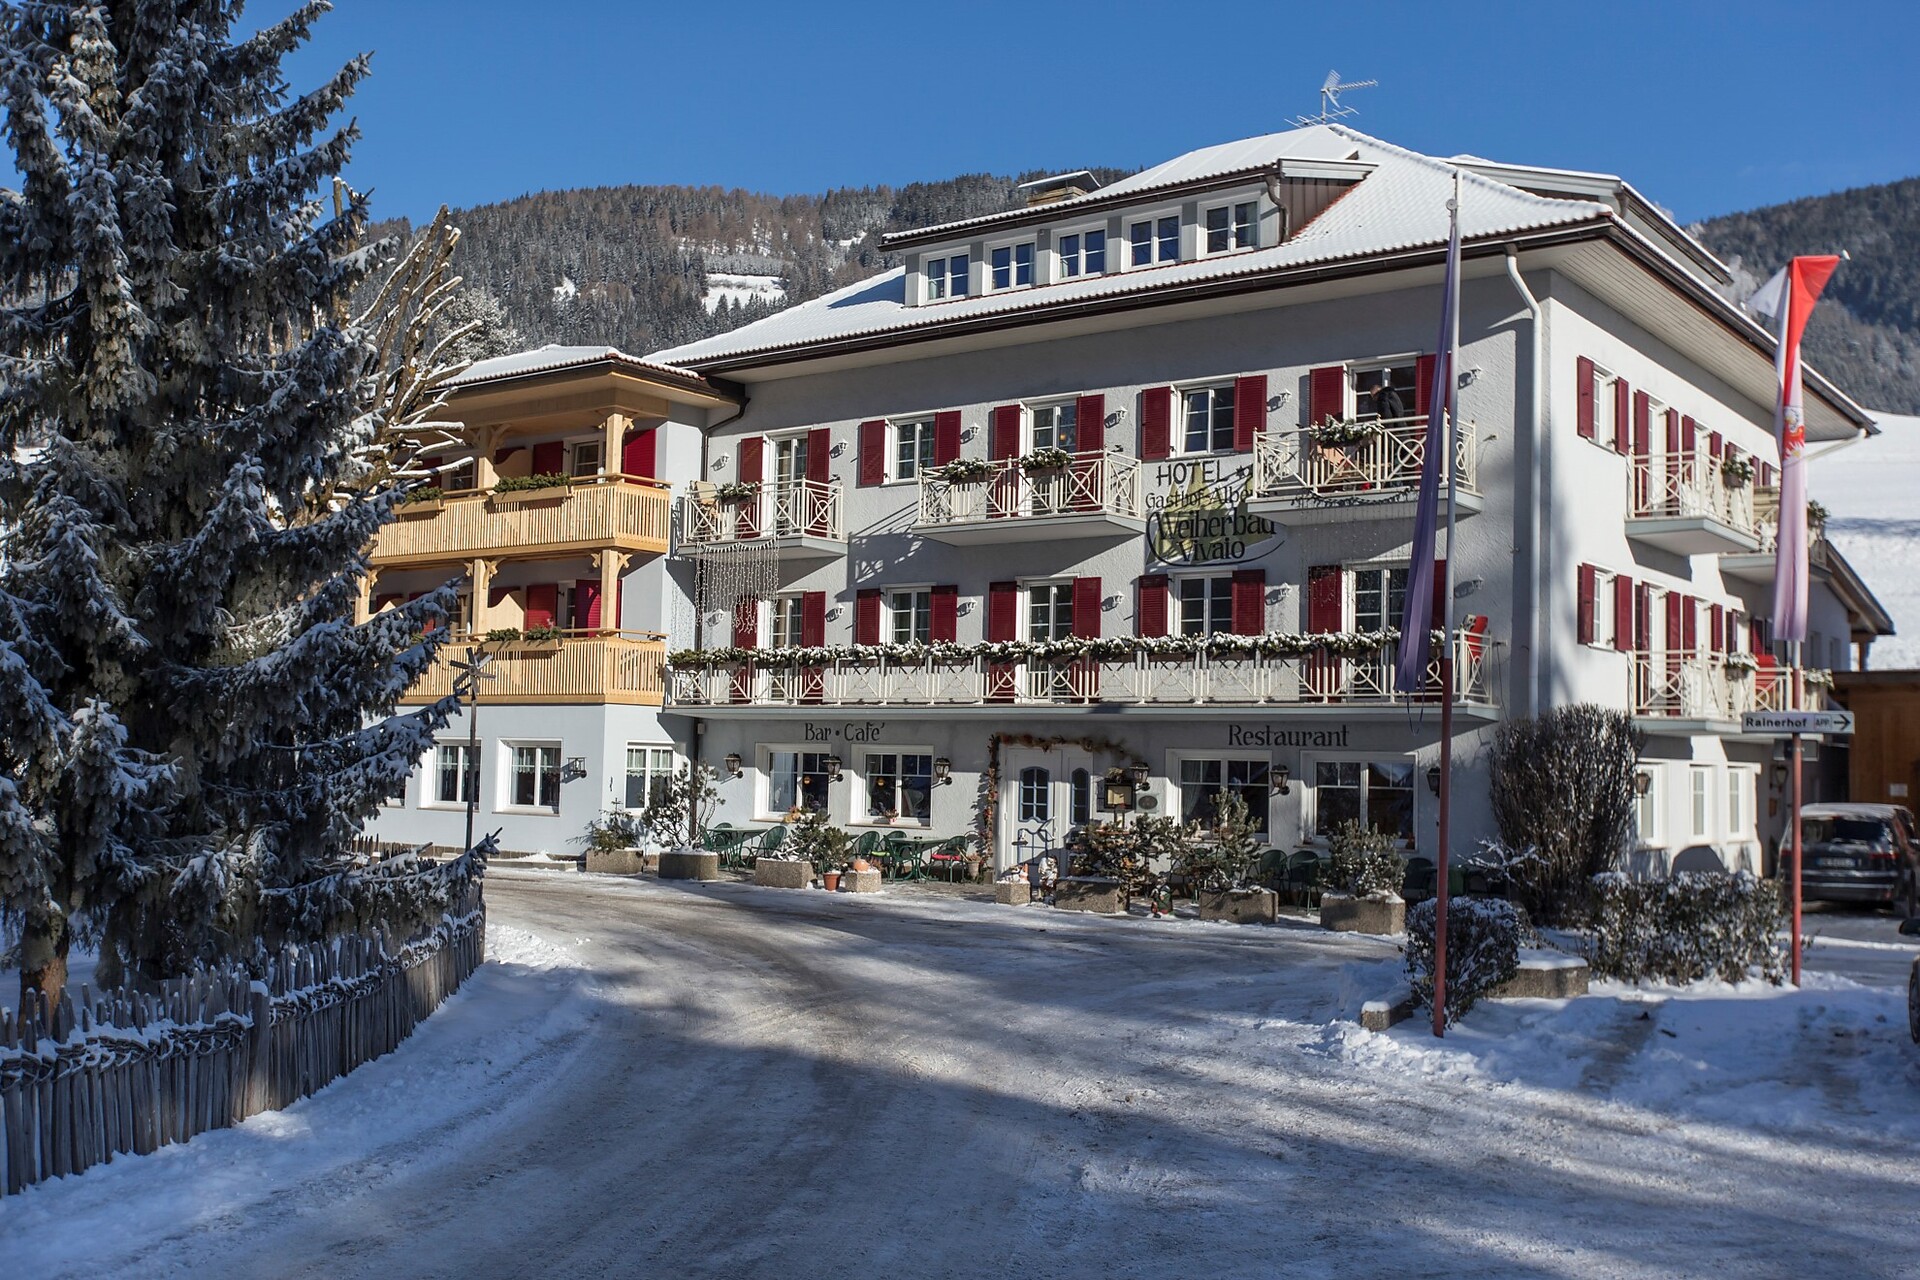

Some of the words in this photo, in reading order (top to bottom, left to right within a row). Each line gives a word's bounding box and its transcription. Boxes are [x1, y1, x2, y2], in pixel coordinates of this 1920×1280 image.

[1156, 459, 1223, 486] HOTEL
[1176, 537, 1245, 561] Vivaio
[805, 722, 831, 741] Bar
[1746, 717, 1807, 728] Rainerhof
[1228, 724, 1349, 747] Restaurant
